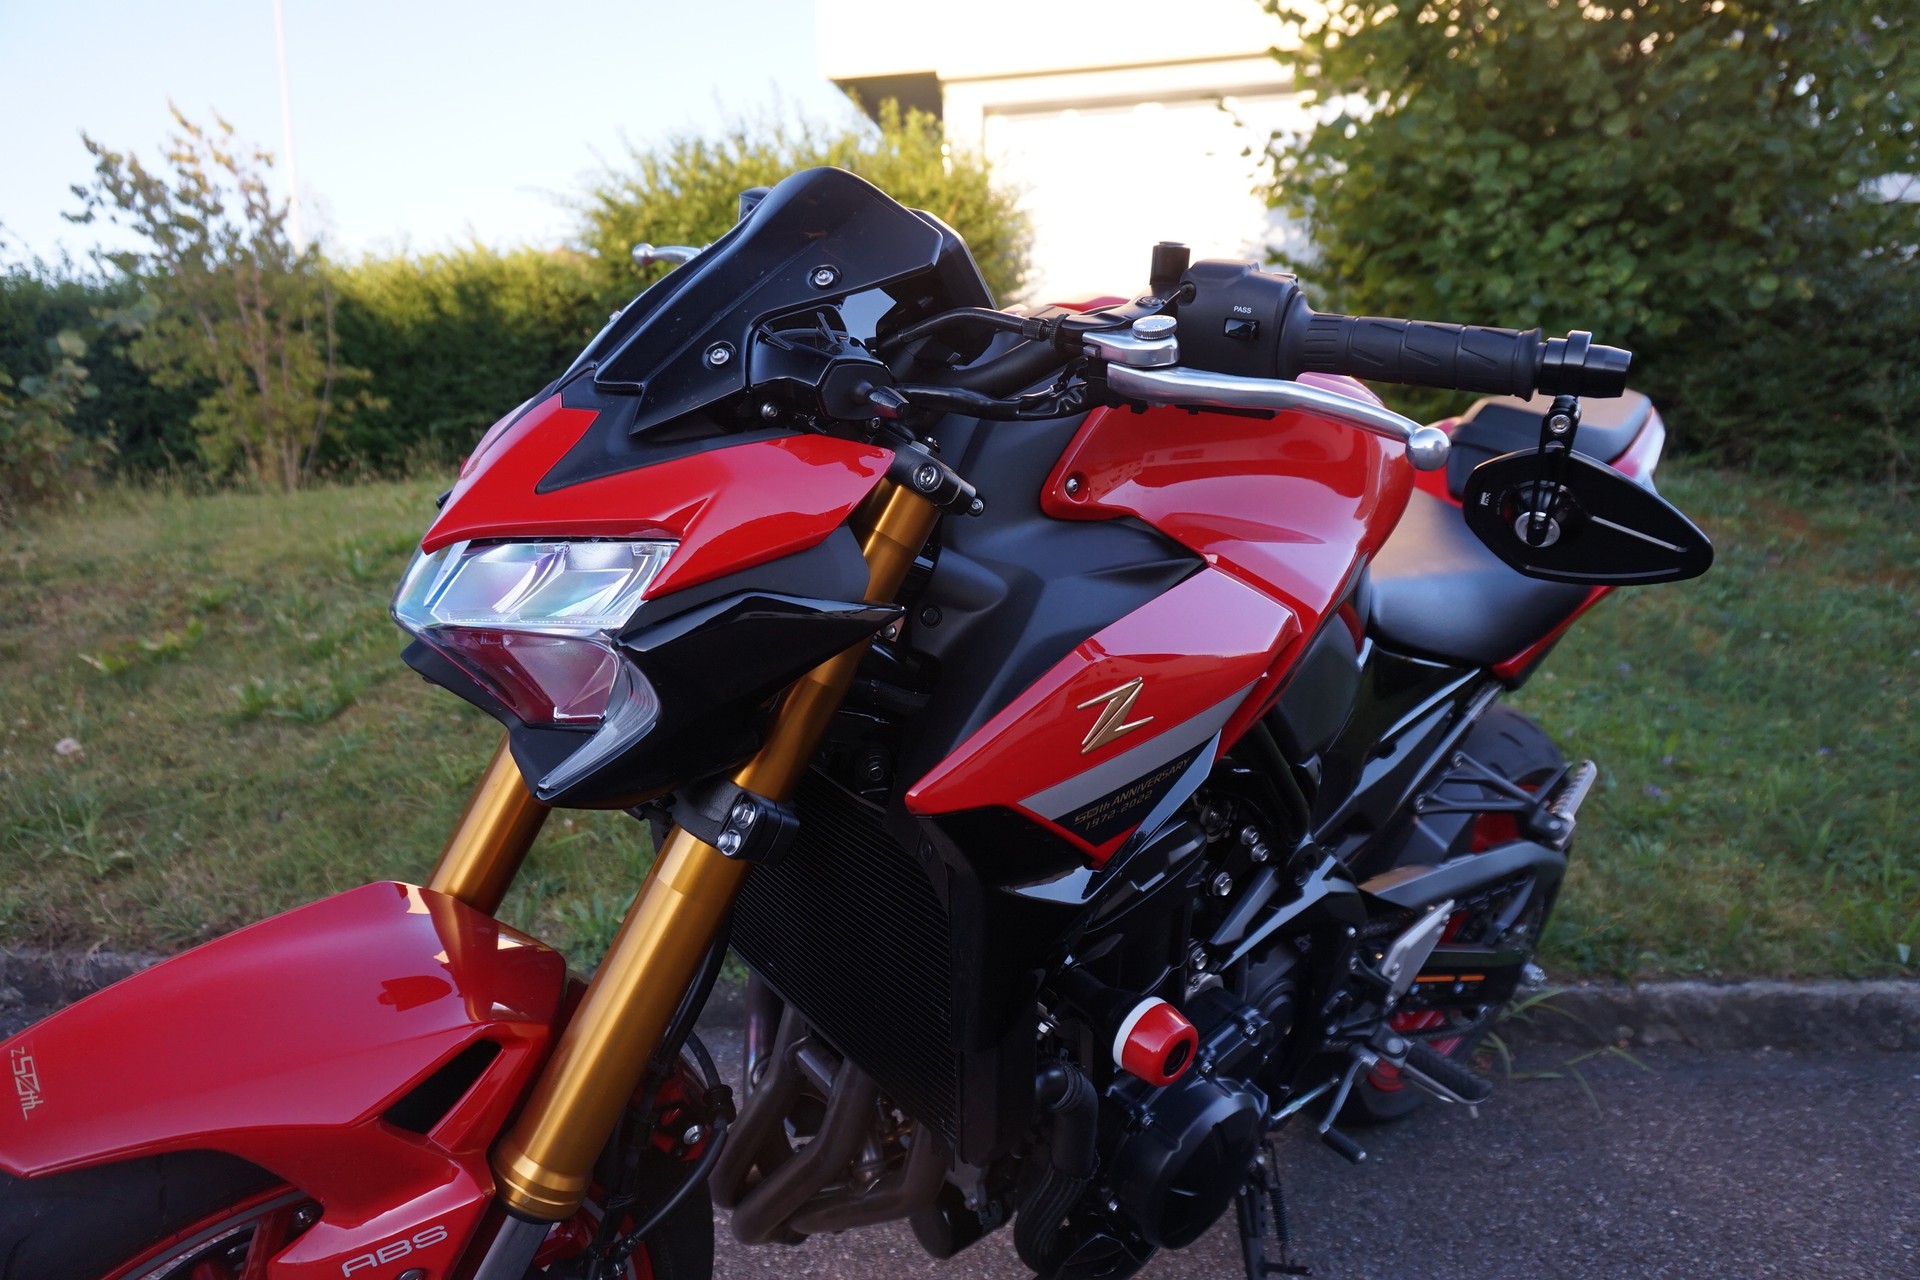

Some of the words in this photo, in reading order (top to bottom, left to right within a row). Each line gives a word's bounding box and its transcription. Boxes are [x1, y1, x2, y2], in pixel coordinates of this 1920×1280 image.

[1233, 305, 1252, 314] PASS
[1076, 676, 1154, 755] Z
[1111, 756, 1191, 807] ANNIVERSARY
[1085, 789, 1153, 831] 1972-2022
[341, 1225, 448, 1278] ABS
